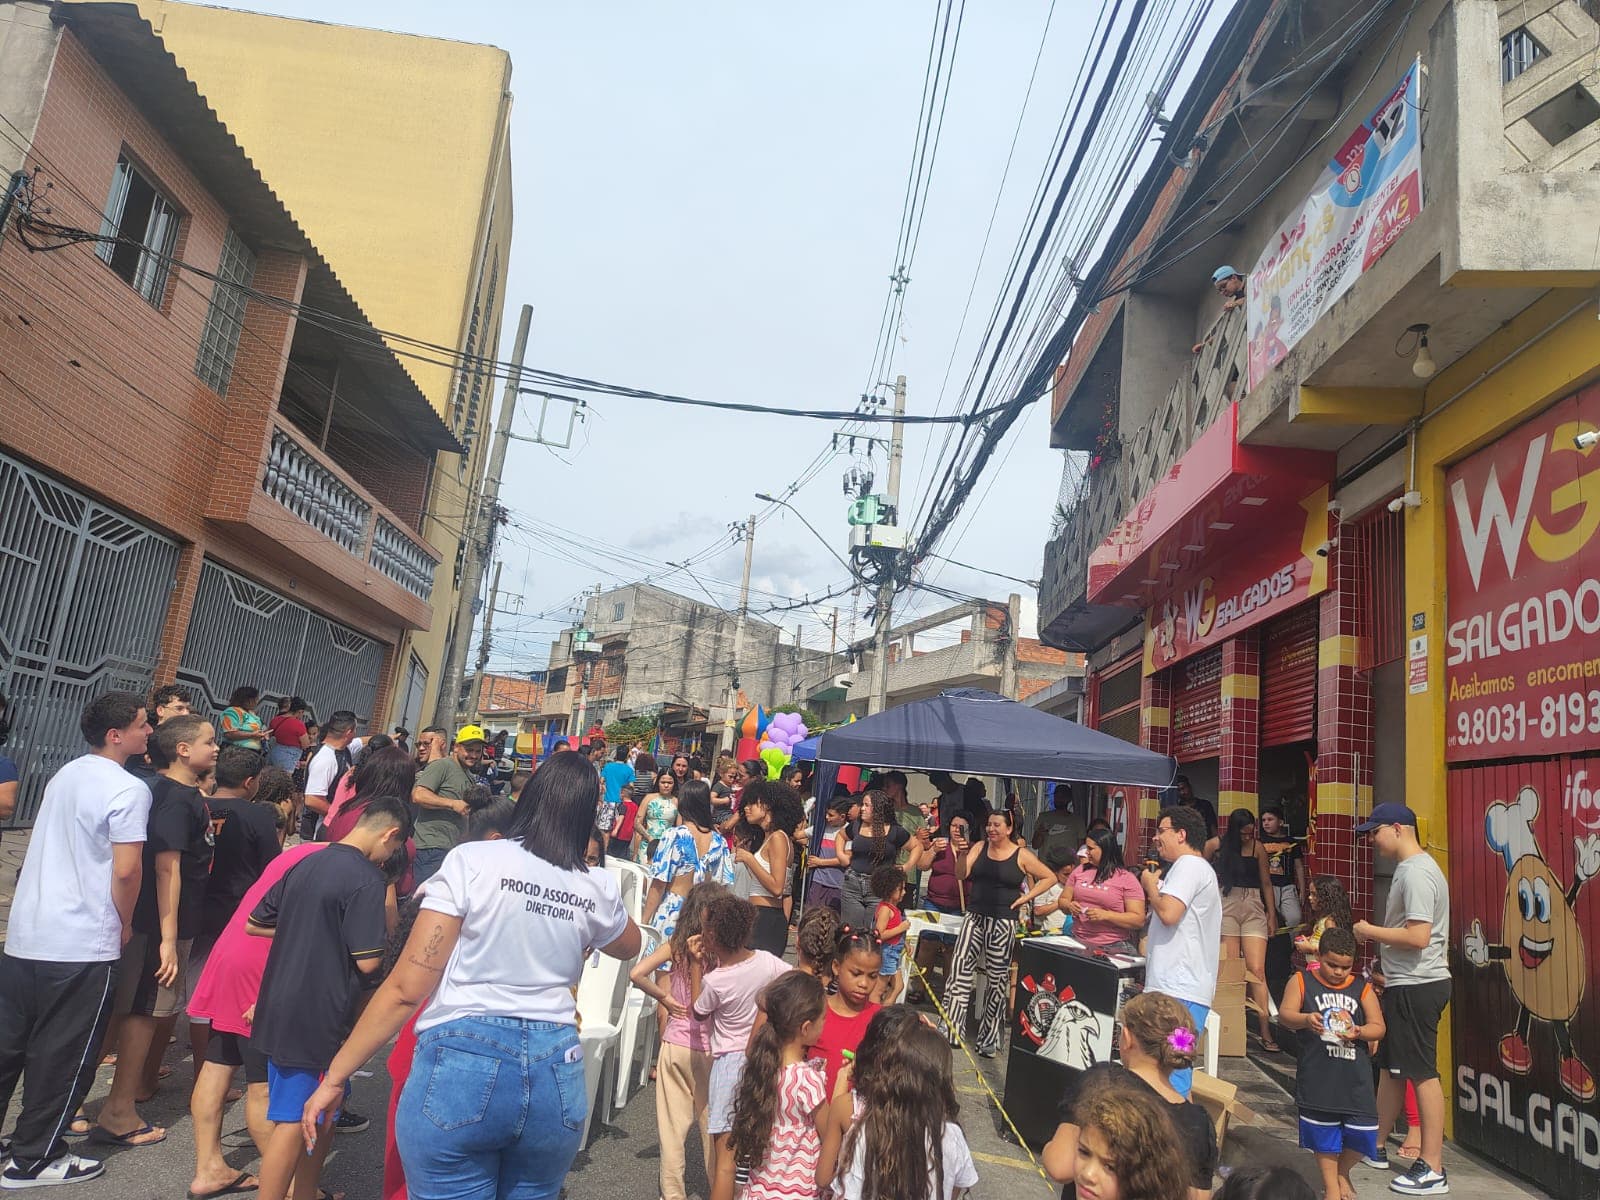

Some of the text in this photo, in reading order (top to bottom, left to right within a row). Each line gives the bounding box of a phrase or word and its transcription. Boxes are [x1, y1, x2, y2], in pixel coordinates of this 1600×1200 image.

[1374, 101, 1405, 144] 12
[1384, 193, 1409, 227] WG
[1451, 421, 1600, 593] WG
[1184, 563, 1296, 644] WG SALGADOS
[1447, 578, 1600, 667] SALGADO
[1449, 671, 1515, 702] Aceitamos
[500, 878, 596, 914] PROCID ASSOCIAÇÃO
[525, 900, 575, 922] DIRETORIA
[1314, 993, 1358, 1015] LOONEY
[1326, 1045, 1356, 1060] TUNES
